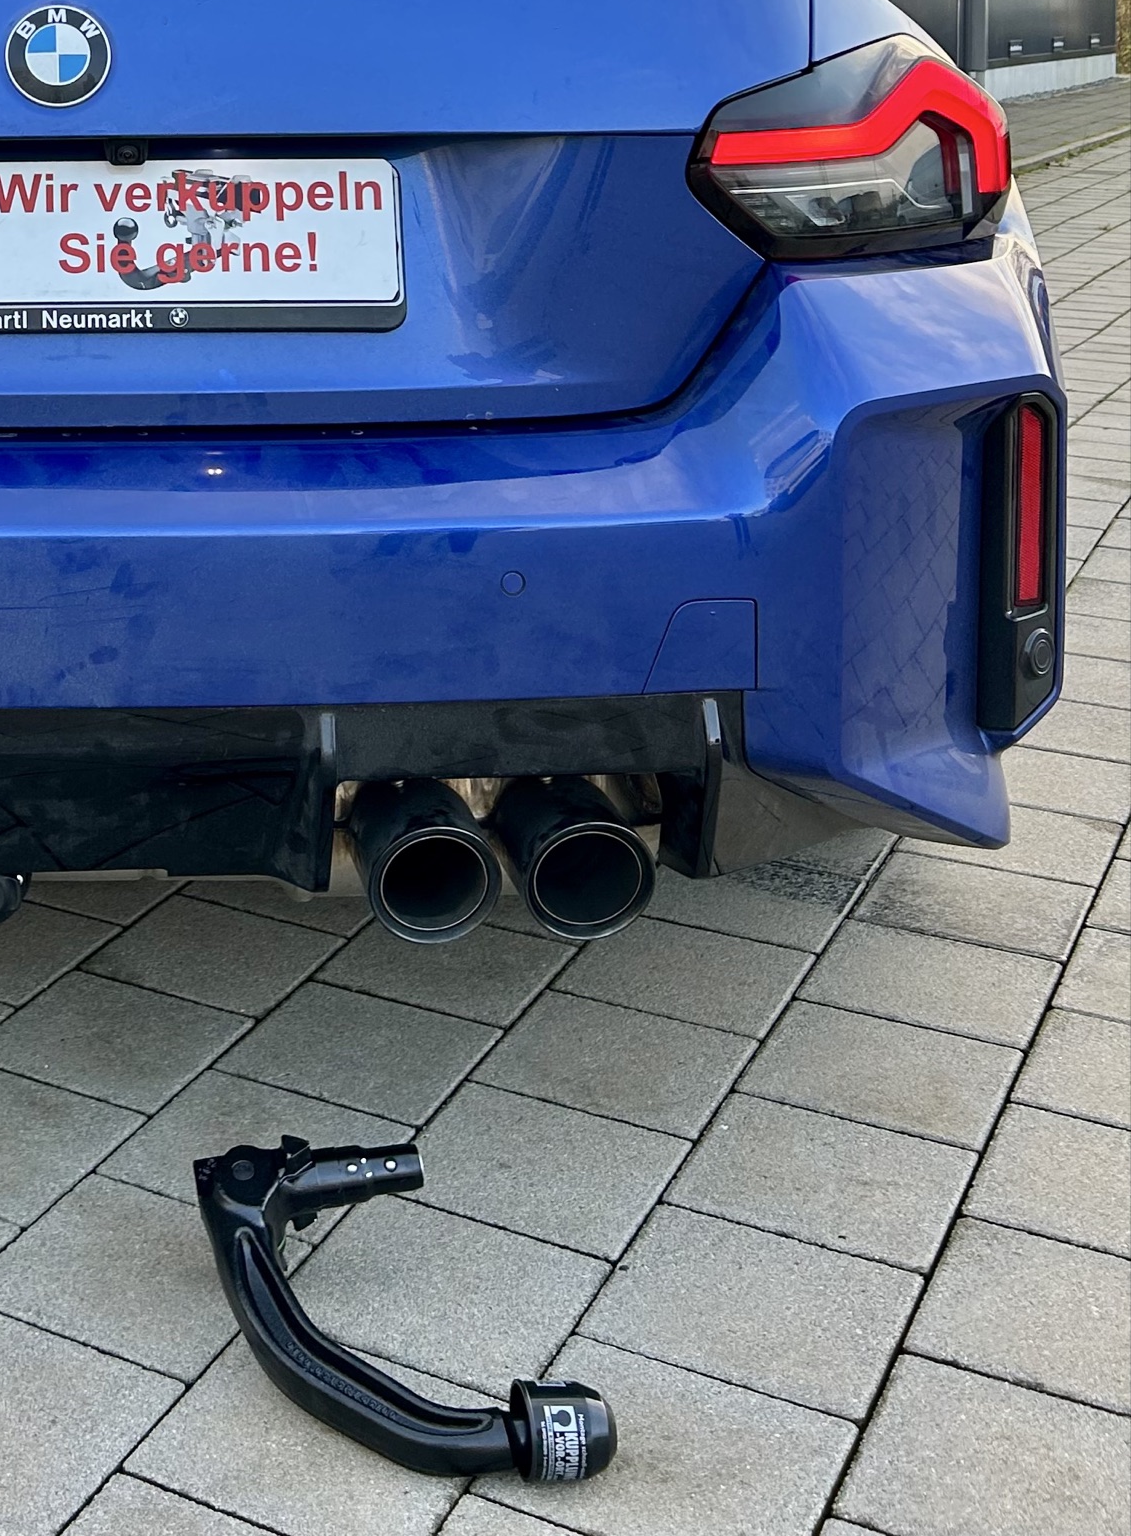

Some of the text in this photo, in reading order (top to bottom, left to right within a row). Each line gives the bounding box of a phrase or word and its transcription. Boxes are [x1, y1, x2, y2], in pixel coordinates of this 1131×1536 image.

[16, 8, 100, 40] BMW
[93, 170, 383, 222] verkuppeln
[58, 231, 318, 284] Sie gerne!
[41, 309, 153, 329] Neumarkt
